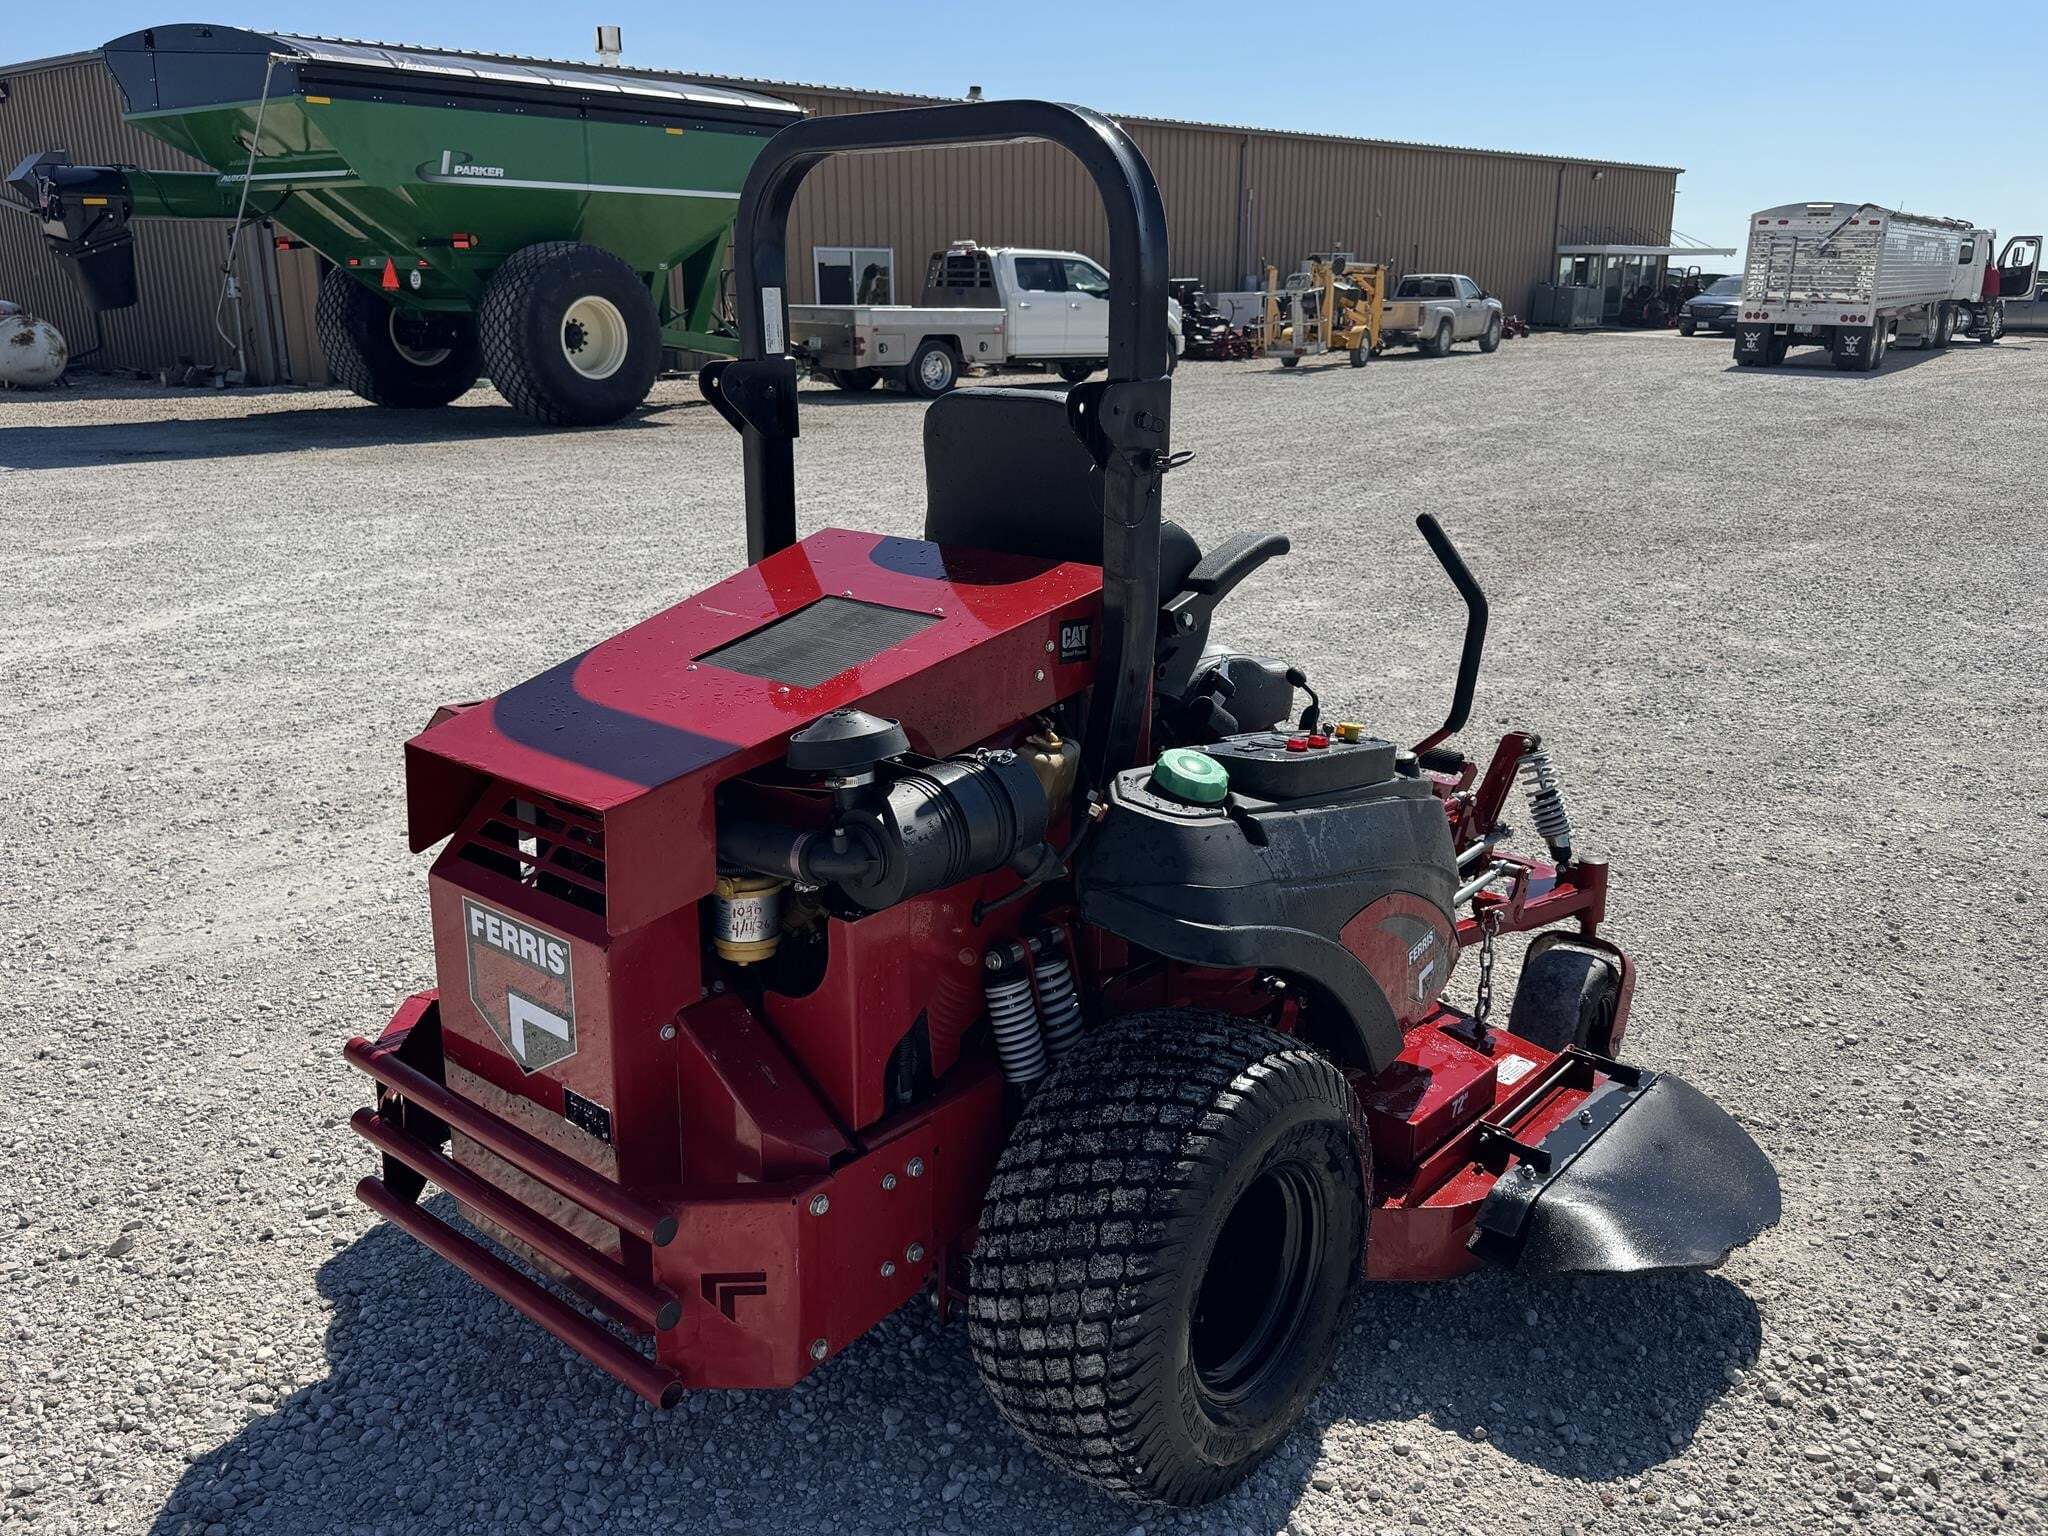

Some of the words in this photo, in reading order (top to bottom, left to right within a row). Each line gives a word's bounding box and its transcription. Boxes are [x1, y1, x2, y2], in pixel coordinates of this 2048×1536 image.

[454, 166, 504, 177] PARKER
[1062, 625, 1088, 648] CAT
[1408, 930, 1434, 966] FERRIS
